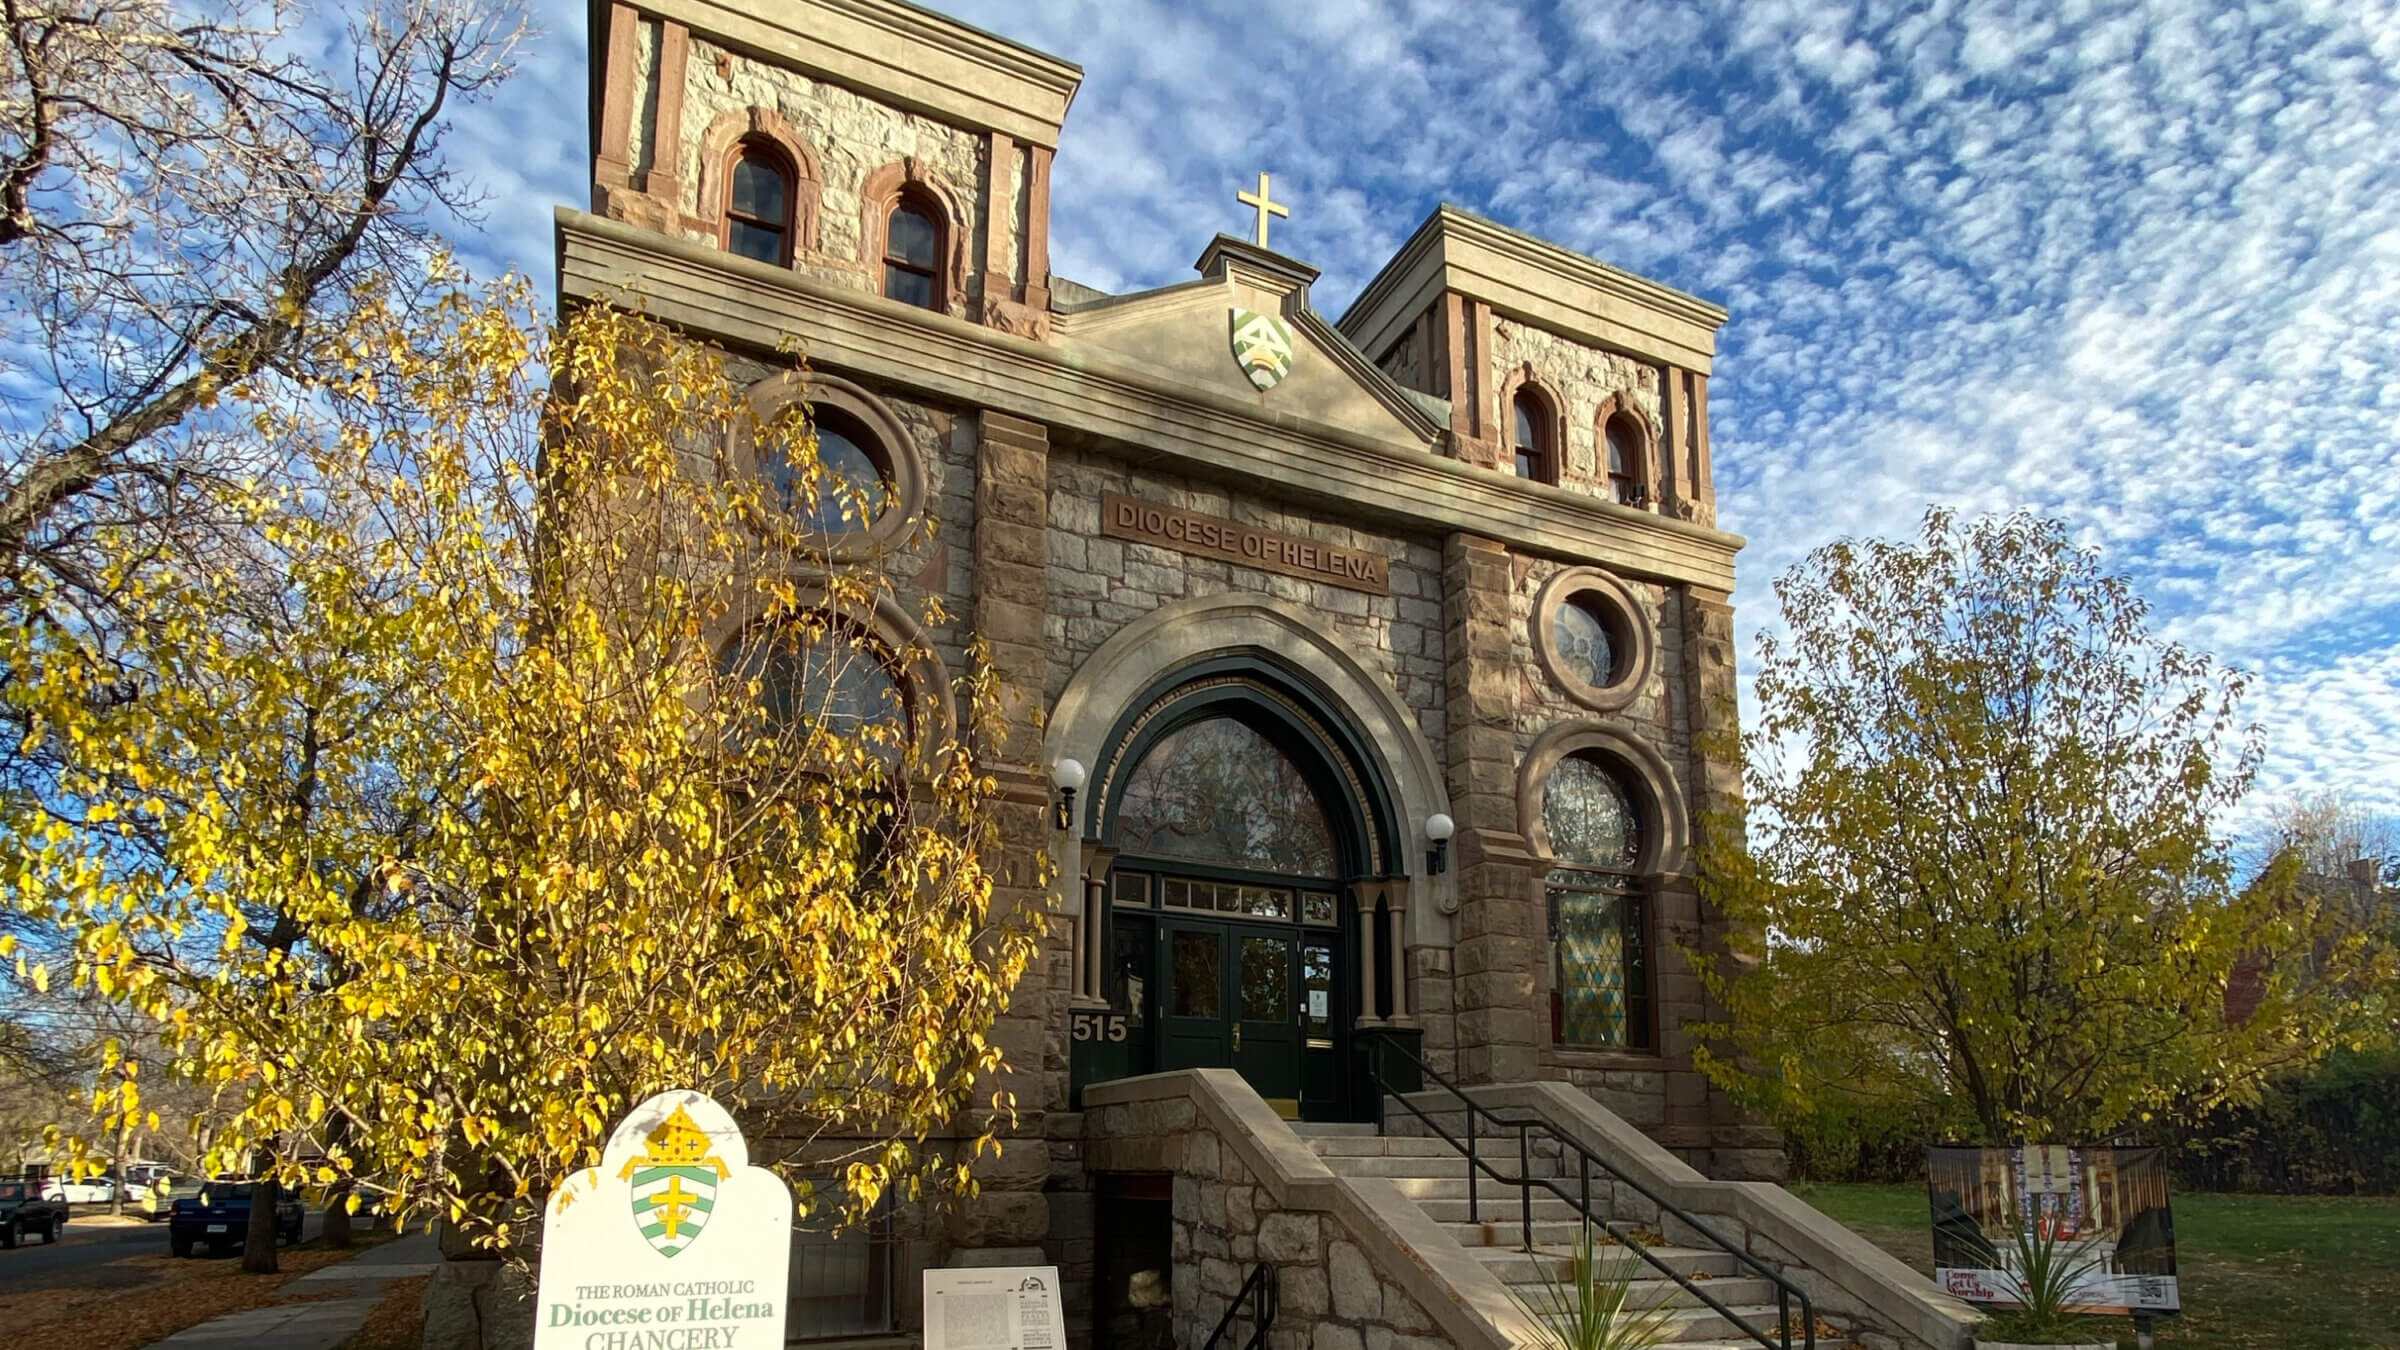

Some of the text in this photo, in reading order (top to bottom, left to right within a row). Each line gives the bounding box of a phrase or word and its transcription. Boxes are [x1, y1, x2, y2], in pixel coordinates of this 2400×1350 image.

[1117, 502, 1380, 583] DIOCESE OF HELENA
[1072, 1015, 1127, 1042] 515
[1946, 1269, 1977, 1280] Come
[576, 1280, 755, 1300] THE ROMAN CATHOLIC
[1946, 1288, 1995, 1300] Worship
[548, 1298, 774, 1328] Diocese OF Helena
[585, 1326, 740, 1350] CHANCERY
